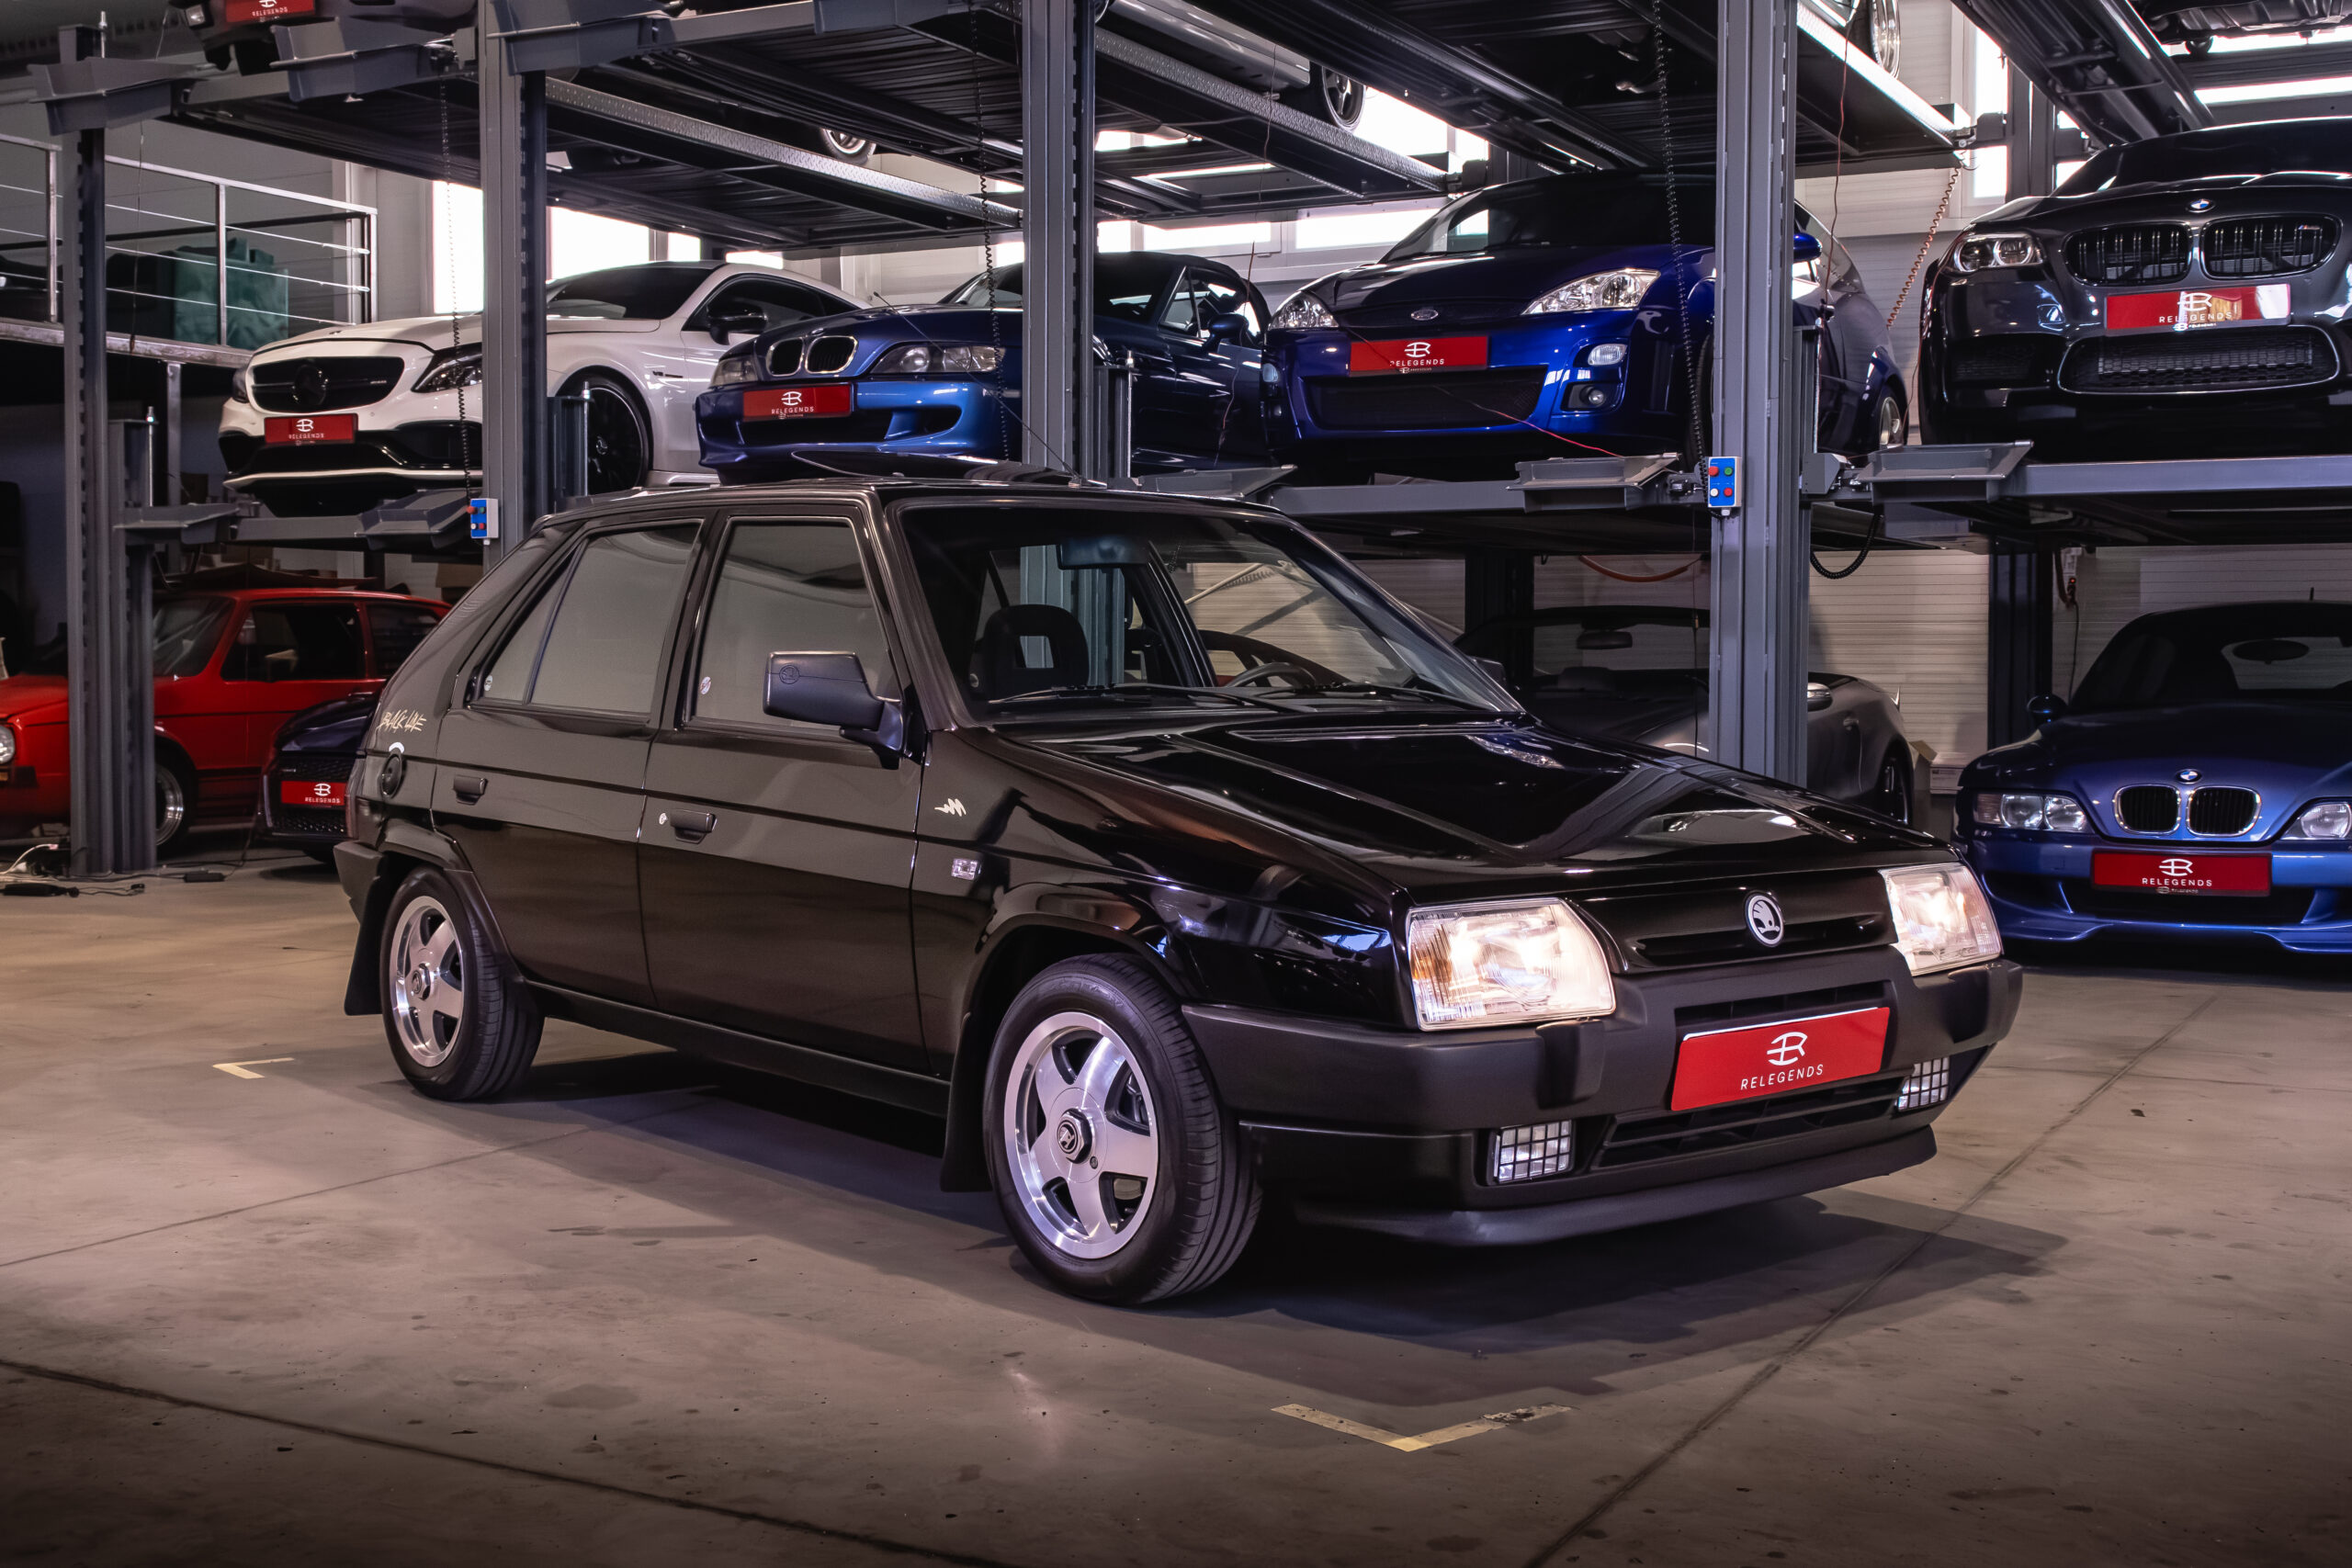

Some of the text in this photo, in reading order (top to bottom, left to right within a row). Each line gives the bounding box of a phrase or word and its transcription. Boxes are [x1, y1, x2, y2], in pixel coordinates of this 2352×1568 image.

[771, 406, 815, 415] RELEGENDS
[2142, 877, 2212, 887] RELEGENDS
[1740, 1064, 1824, 1091] RELEGENDS
